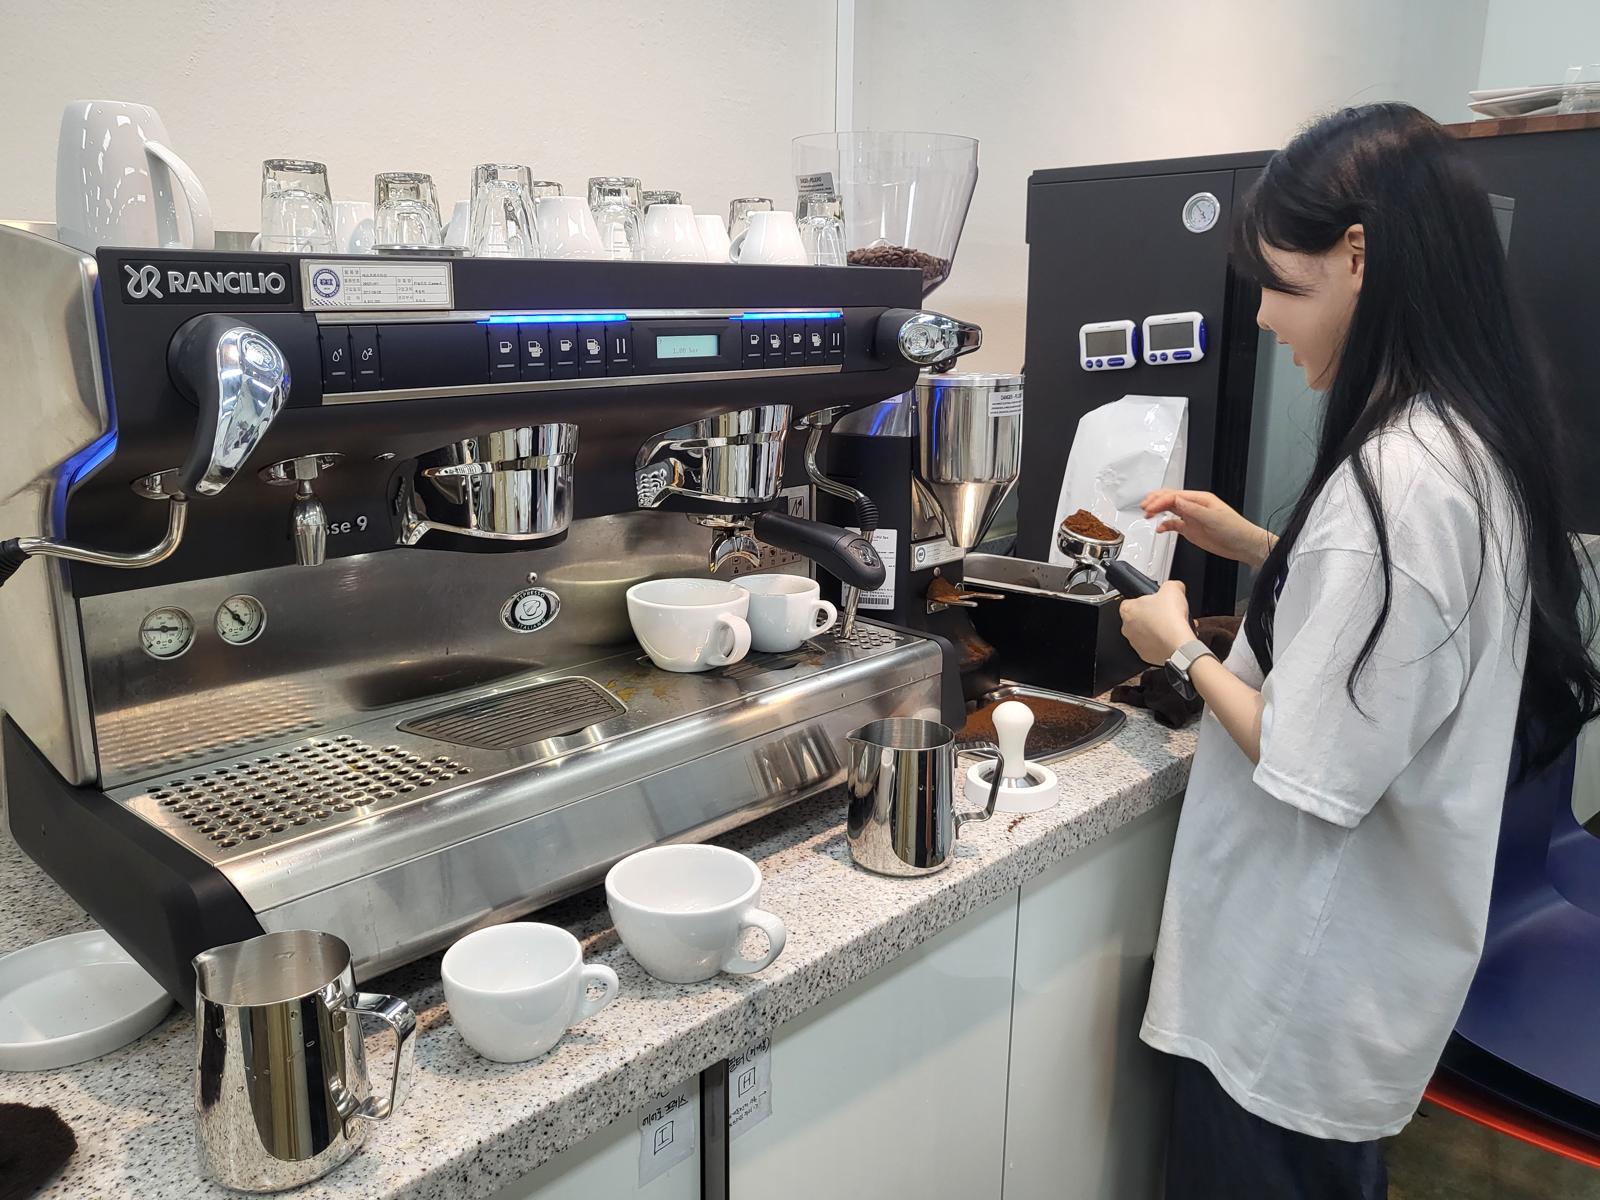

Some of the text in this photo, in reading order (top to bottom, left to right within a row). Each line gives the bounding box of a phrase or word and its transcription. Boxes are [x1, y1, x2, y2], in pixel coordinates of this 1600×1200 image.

[168, 271, 286, 295] RANCILIO
[356, 515, 368, 531] 9
[516, 590, 545, 602] ESPRESSO
[517, 618, 546, 630] ITALIANO
[743, 1072, 752, 1089] H
